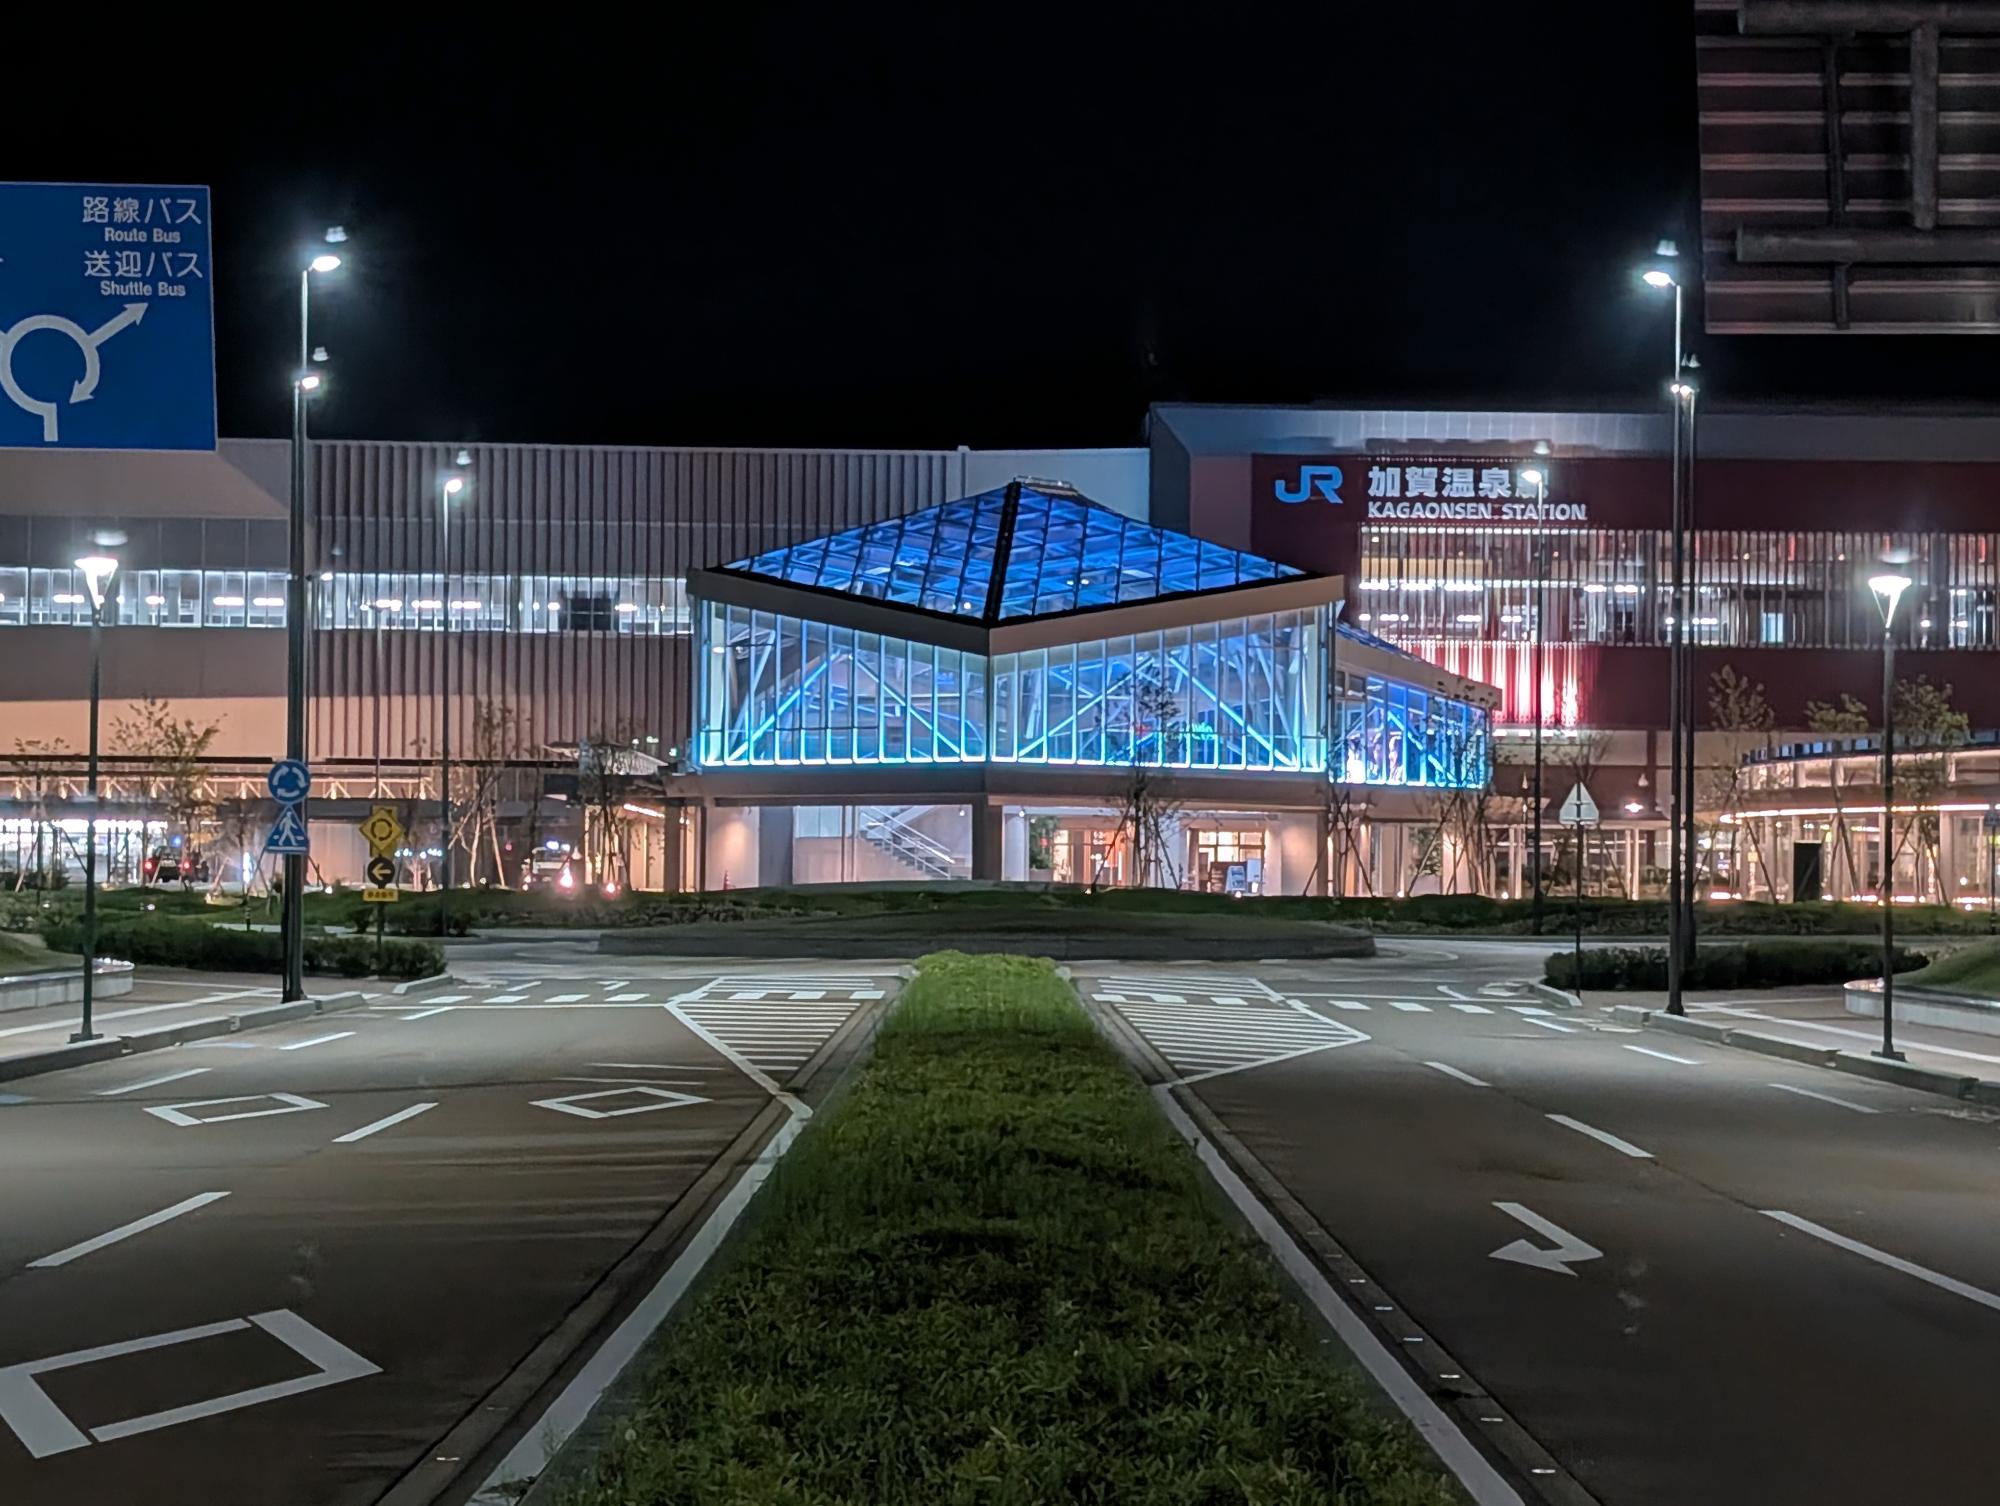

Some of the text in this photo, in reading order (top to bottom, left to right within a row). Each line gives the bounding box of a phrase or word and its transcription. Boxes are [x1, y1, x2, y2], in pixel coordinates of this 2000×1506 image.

[82, 196, 202, 224] 路線バス
[104, 227, 181, 243] Route Bus
[84, 250, 203, 278] 送迎バス
[100, 280, 186, 297] Shuttle Bus
[1275, 465, 1344, 504] JR
[1368, 502, 1588, 521] KAGAONSEN STATION
